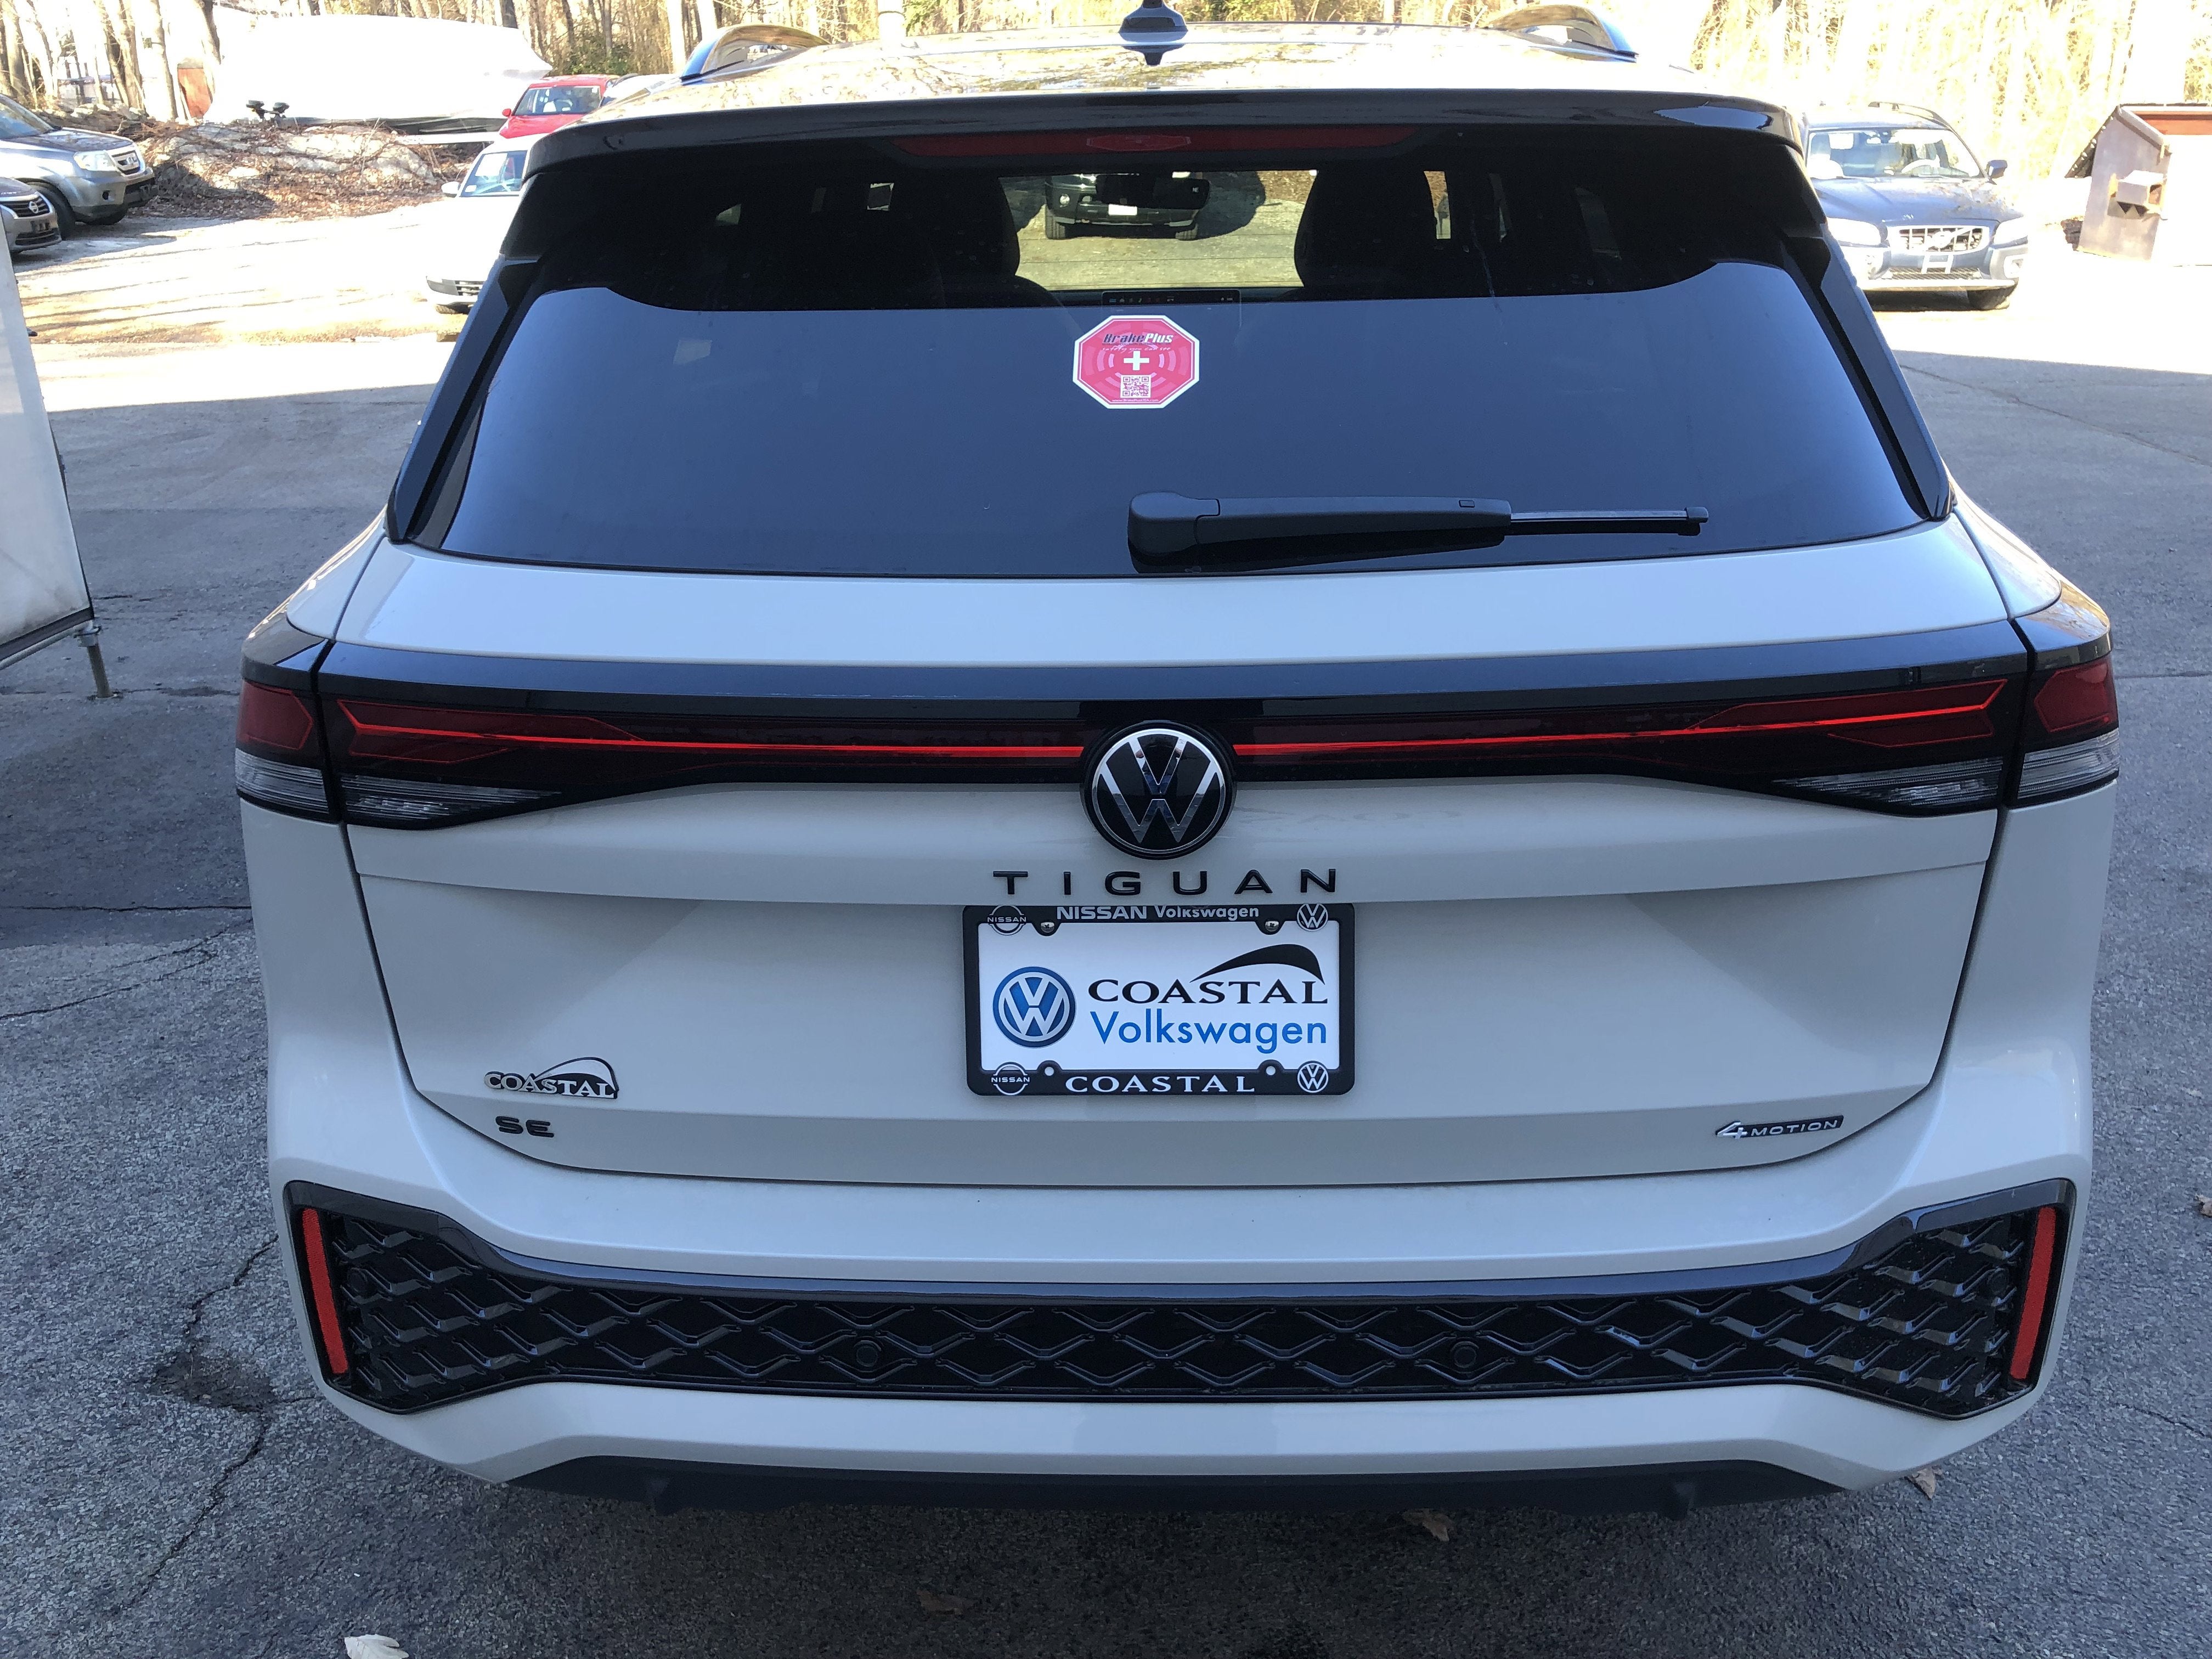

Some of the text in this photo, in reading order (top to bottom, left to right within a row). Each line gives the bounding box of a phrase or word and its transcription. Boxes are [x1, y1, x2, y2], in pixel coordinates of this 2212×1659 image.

[1103, 333, 1174, 343] BrakePlus
[992, 868, 1336, 896] TIGUAN
[1056, 905, 1260, 921] NISSAN Volkswagen
[1088, 978, 1328, 1005] COASTAL
[1089, 1008, 1327, 1054] Volkswagen
[484, 1072, 616, 1099] COASTAL
[1065, 1075, 1255, 1093] COASTAL
[495, 1116, 555, 1138] SE
[1716, 1119, 1839, 1139] 4MOTION
